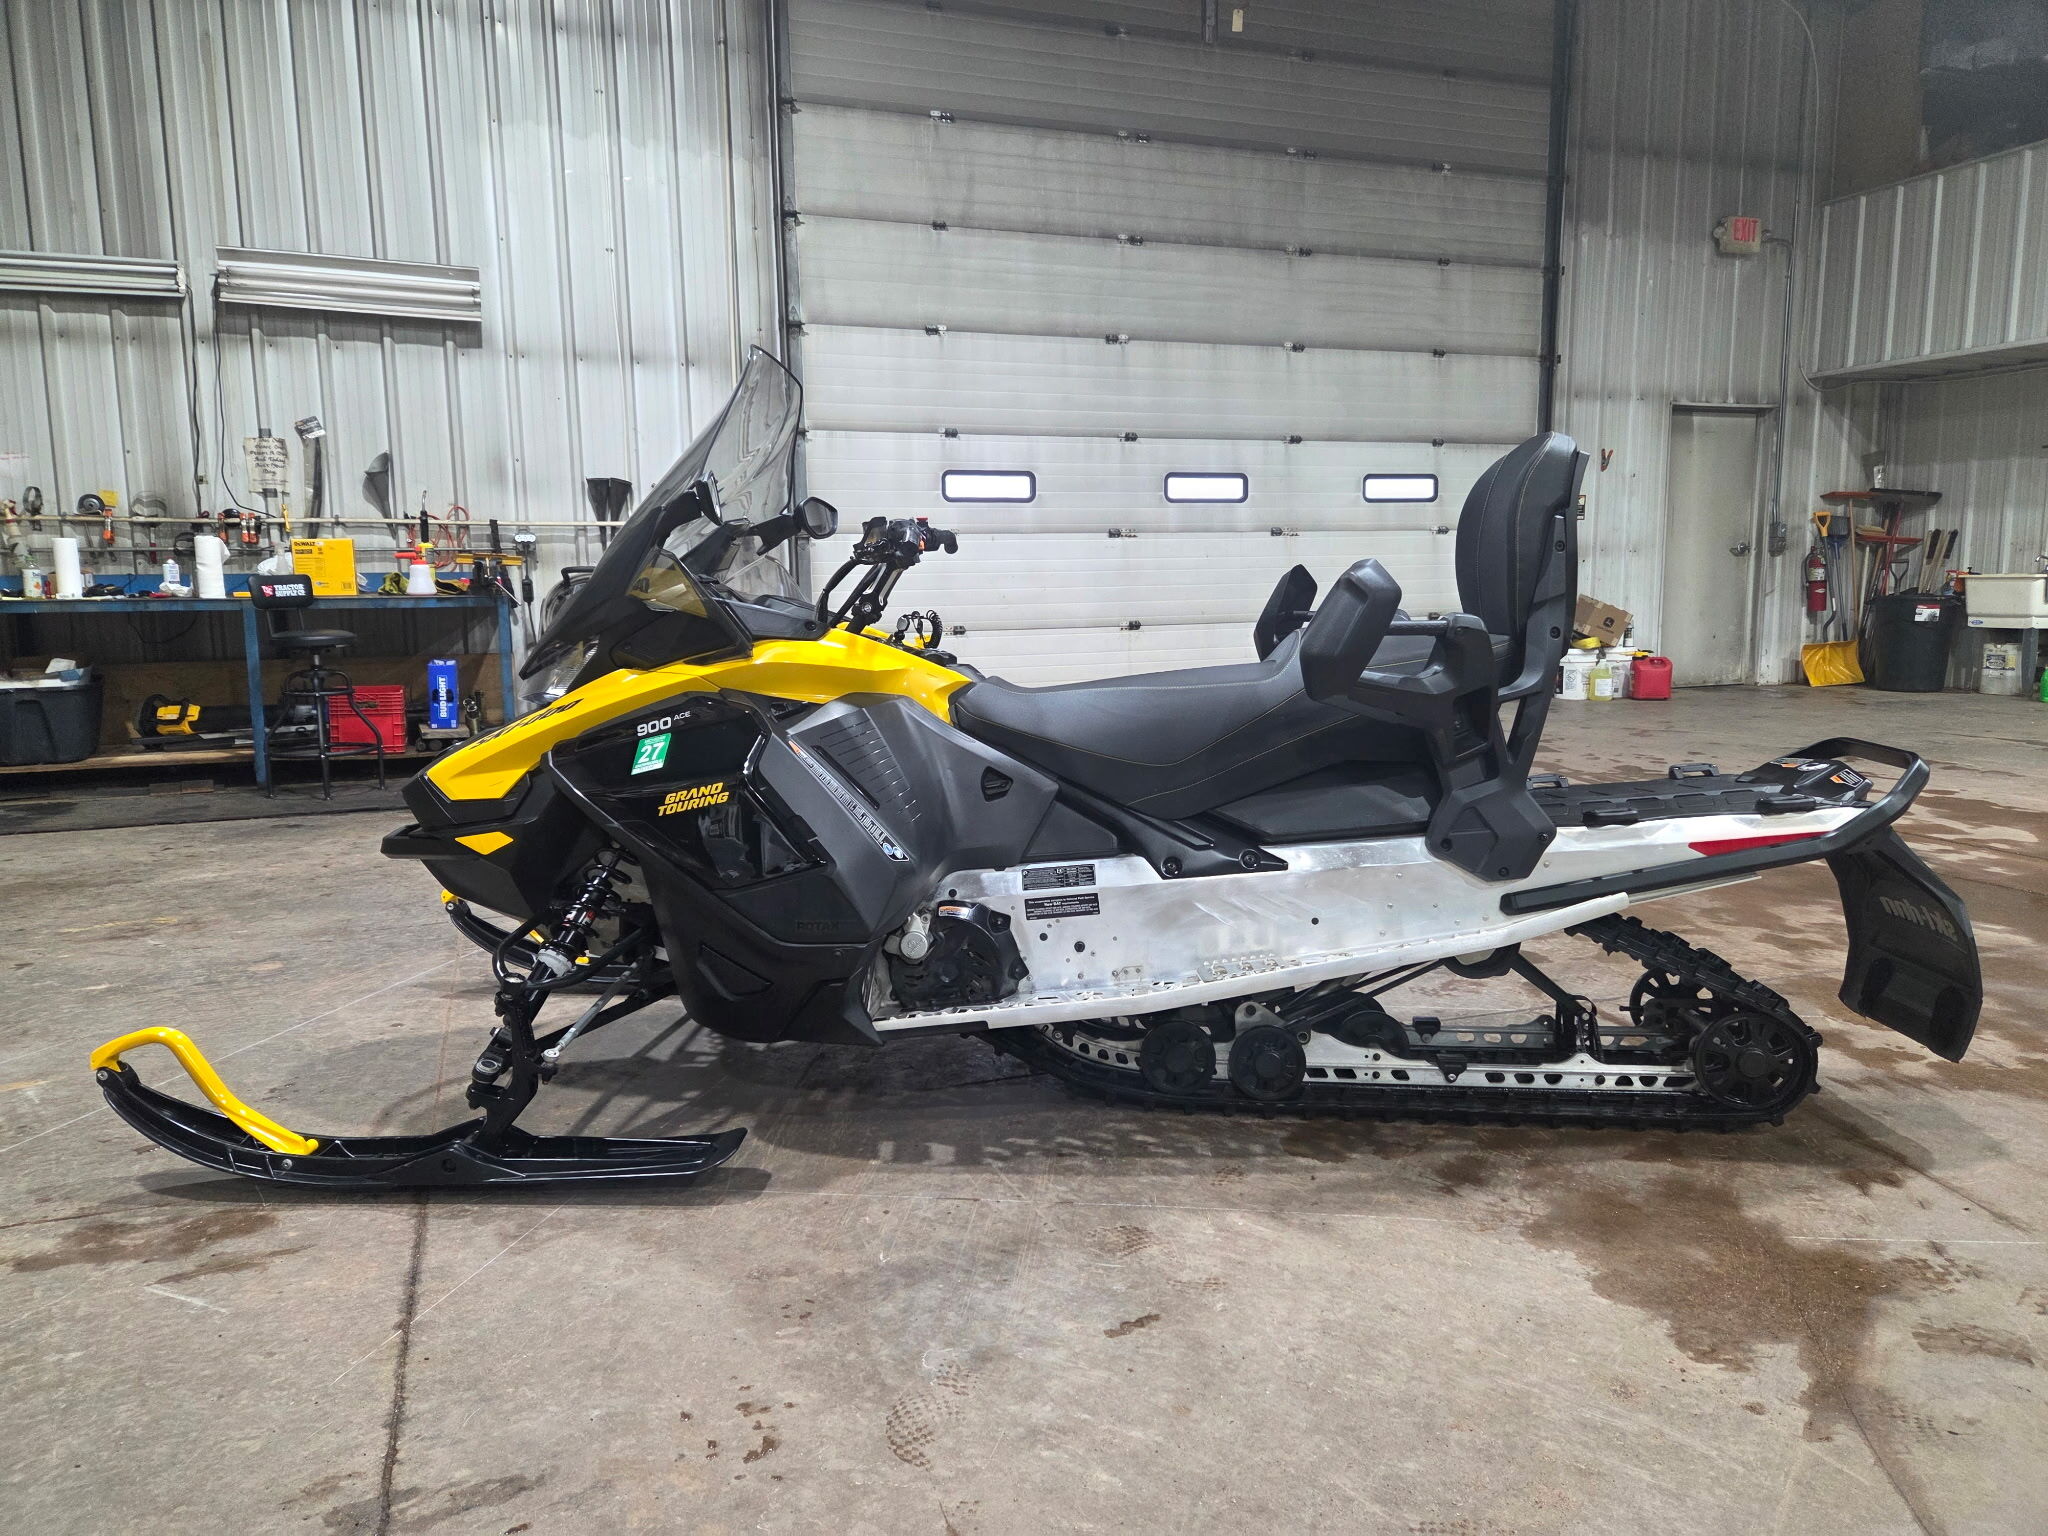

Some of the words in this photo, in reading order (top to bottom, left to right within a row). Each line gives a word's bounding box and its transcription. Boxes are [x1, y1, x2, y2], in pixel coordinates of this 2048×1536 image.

[1733, 218, 1759, 242] EXIT
[438, 676, 447, 700] LIGHT
[439, 700, 447, 718] BUD
[636, 716, 672, 737] 900
[673, 710, 692, 721] ACE
[637, 741, 665, 764] 27
[657, 791, 730, 817] TOURING
[664, 781, 724, 805] GRAND
